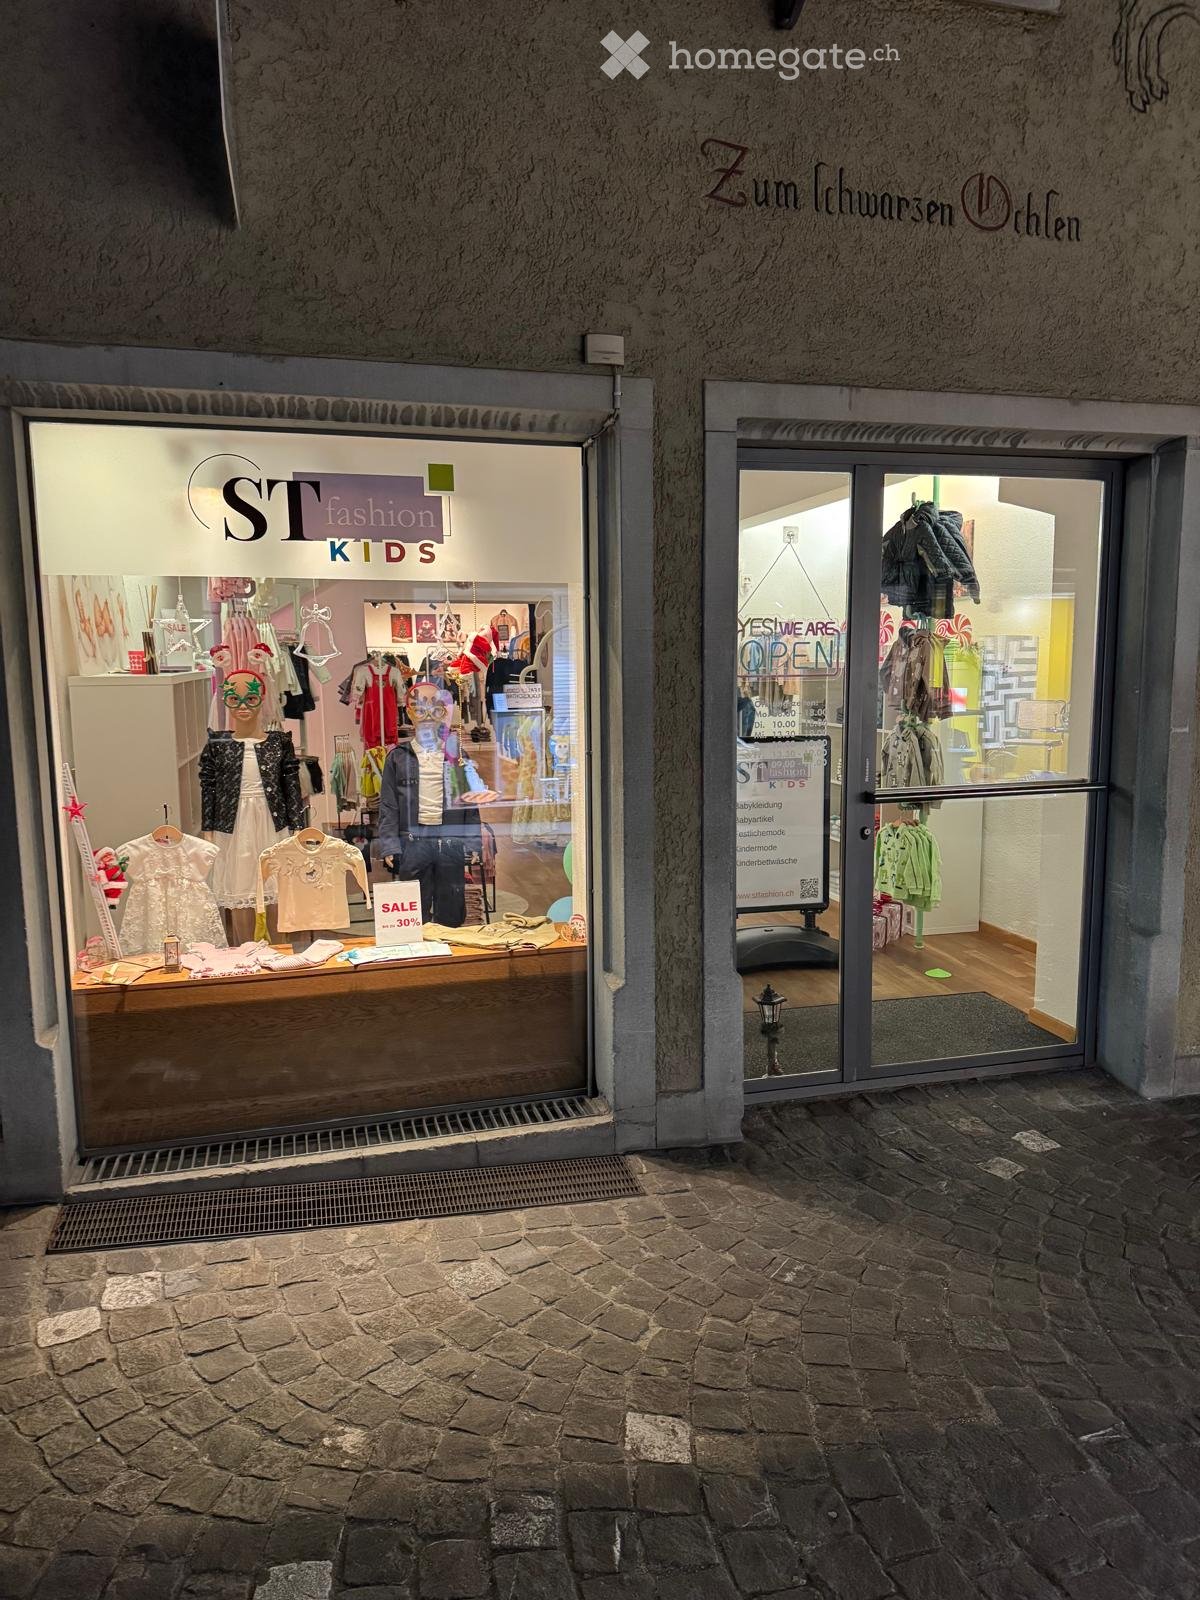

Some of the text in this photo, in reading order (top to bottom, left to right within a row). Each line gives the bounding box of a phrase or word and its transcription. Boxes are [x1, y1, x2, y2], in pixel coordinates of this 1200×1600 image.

[700, 138, 799, 211] Zum
[222, 476, 437, 542] ST fashion
[329, 540, 436, 564] KIDS
[740, 639, 833, 672] OPEN
[772, 720, 796, 728] 10.00
[381, 901, 418, 913] SALE
[396, 917, 421, 928] 30%
